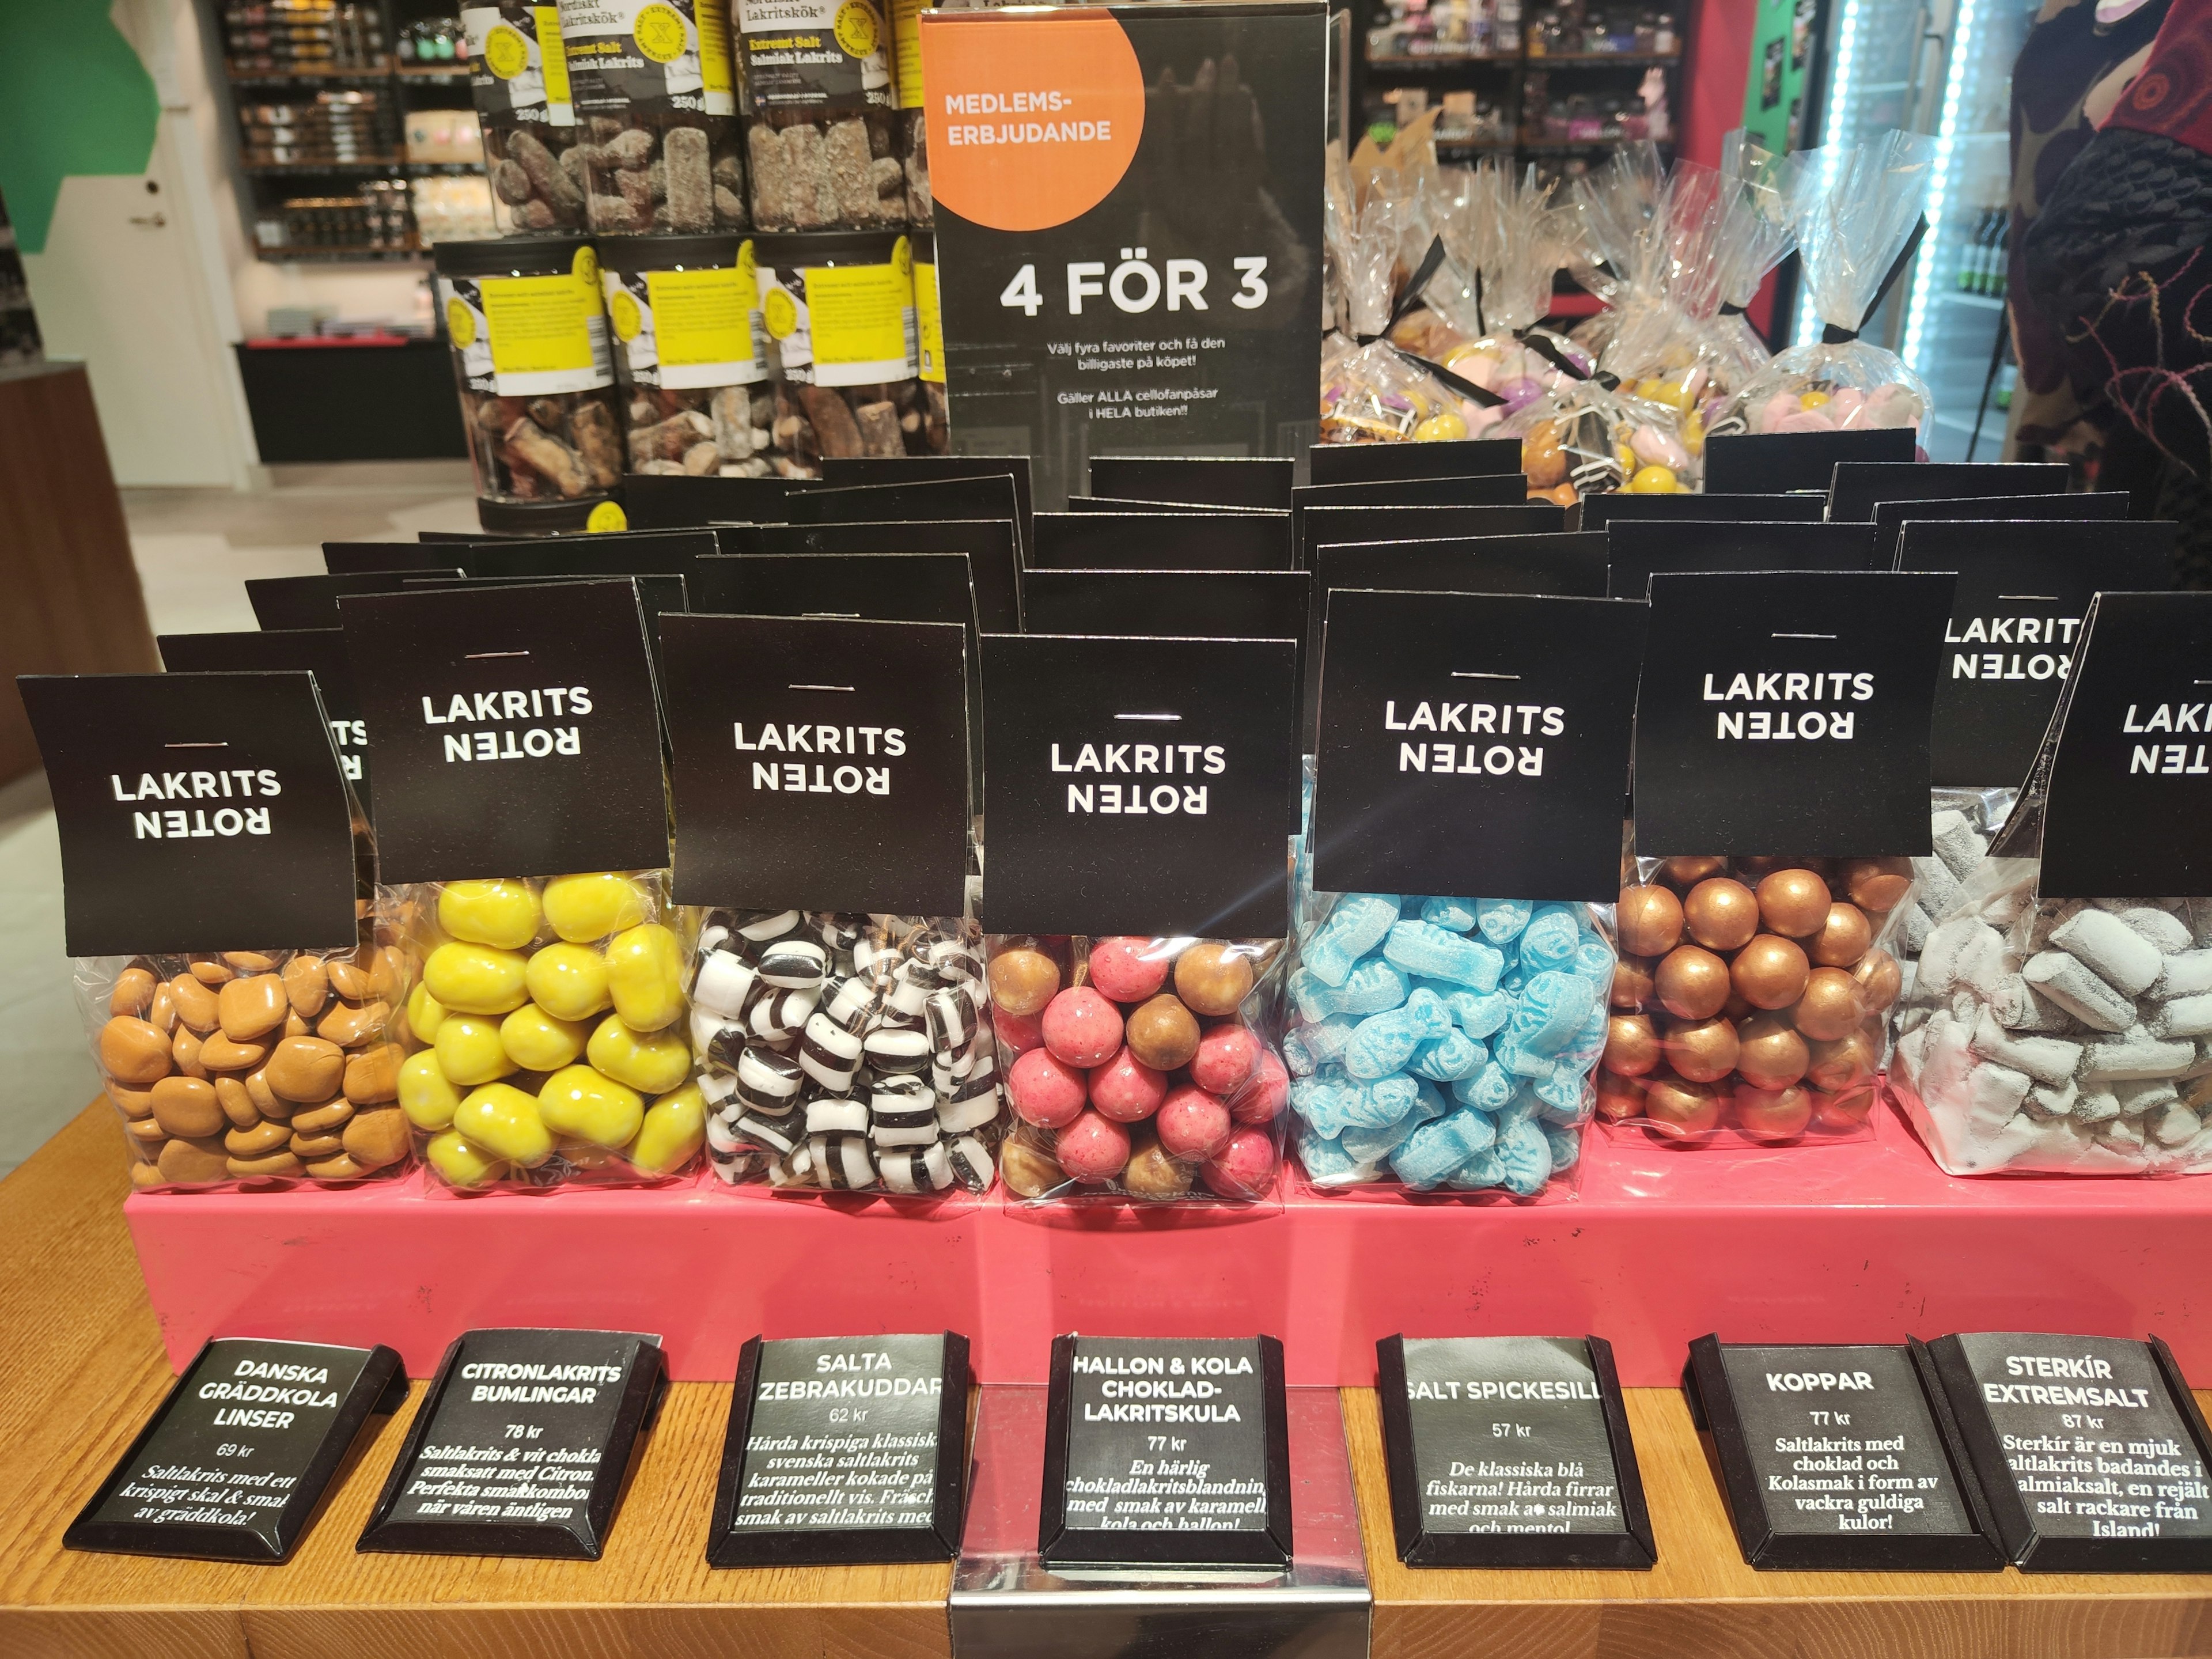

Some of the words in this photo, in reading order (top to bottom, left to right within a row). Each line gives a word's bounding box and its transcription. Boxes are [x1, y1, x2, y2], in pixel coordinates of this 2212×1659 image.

[672, 96, 696, 110] 250
[945, 90, 1072, 115] MEDLEMS-
[948, 120, 1112, 146] ERBJUDANDE
[1000, 264, 1043, 317] 4
[1067, 247, 1209, 315] FÖR
[1231, 256, 1268, 309] 3
[1047, 342, 1072, 356] Välj
[1074, 341, 1100, 356] fyra
[1103, 338, 1156, 353] favoriter
[1158, 338, 1183, 351] och
[1185, 337, 1199, 350] få
[1200, 336, 1226, 349] den
[1077, 357, 1134, 372] billigaste
[1137, 355, 1154, 371] på
[1156, 354, 1196, 369] köpet!
[1056, 391, 1094, 406] Gäller
[1097, 389, 1133, 403] ALLA
[1135, 388, 1219, 403] cellofanpåsar
[1088, 407, 1093, 421] i
[1096, 405, 1132, 419] HELA
[1134, 404, 1188, 418] butiken!!
[1703, 673, 1874, 700] LAKRITS
[422, 687, 593, 724] LAKRITS
[1385, 700, 1565, 736] LAKRITS
[1717, 711, 1855, 740] ROTEN
[443, 727, 581, 763] ROTEN
[734, 722, 906, 756] LAKRITS
[1051, 743, 1226, 775] LAKRITS
[1399, 742, 1544, 776] ROTEN
[111, 769, 282, 802] LAKRITS
[752, 762, 890, 795] ROTEN
[1068, 784, 1207, 815] ROTEN
[133, 807, 272, 839] ROTEN
[234, 1359, 329, 1384] DANSKA
[461, 1363, 623, 1382] CITRONLAKRITS
[816, 1352, 892, 1373] SALTA
[1073, 1355, 1164, 1374] HALLON
[1169, 1357, 1185, 1375] &
[1191, 1357, 1253, 1375] KOLA
[2006, 1354, 2113, 1380] STERKÍR
[757, 1377, 942, 1401] ZEBRAKUDDAR
[1101, 1380, 1222, 1399] CHOKLAD-
[1407, 1381, 1461, 1400] SALT
[1467, 1381, 1603, 1400] SPICKESILL
[1766, 1372, 1874, 1392] KOPPAR
[198, 1380, 338, 1408] GRÄDDKOLA
[471, 1385, 597, 1404] BUMLINGAR
[1983, 1383, 2149, 1408] EXTREMSALT
[213, 1408, 295, 1429] LINSER
[828, 1408, 849, 1423] 62
[853, 1407, 869, 1422] kr
[1084, 1403, 1241, 1423] LAKRITSKULA
[1809, 1411, 1830, 1426] 77
[1834, 1411, 1851, 1426] kr
[2062, 1414, 2082, 1429] 87
[2087, 1415, 2104, 1429] kr
[504, 1424, 524, 1439] 78
[525, 1424, 544, 1439] kr
[1491, 1423, 1511, 1437] 57
[1516, 1423, 1532, 1437] kr
[216, 1443, 237, 1457] 69
[237, 1444, 255, 1458] kr
[745, 1435, 798, 1451] Hårda
[800, 1433, 870, 1453] krispiga
[1147, 1435, 1168, 1452] 77
[1171, 1435, 1187, 1452] kr
[1775, 1436, 1862, 1453] Saltlakrits
[1865, 1435, 1904, 1451] med
[2003, 1435, 2071, 1452] Sterkír
[2074, 1438, 2096, 1453] är
[2100, 1441, 2124, 1455] en
[2128, 1440, 2181, 1459] mjuk
[418, 1445, 503, 1463] Saltlakrits
[503, 1447, 522, 1463] &
[523, 1448, 545, 1463] vit
[766, 1453, 834, 1469] svenska
[835, 1451, 920, 1468] saltlakrits
[1793, 1455, 1862, 1471] choklad
[1866, 1455, 1899, 1470] och
[141, 1464, 229, 1484] Saltlakrits
[229, 1470, 270, 1487] med
[270, 1475, 298, 1490] ett
[421, 1464, 498, 1480] smaksatt
[498, 1465, 537, 1480] med
[537, 1465, 594, 1482] Citron.
[1128, 1459, 1155, 1476] En
[1156, 1459, 1210, 1479] härlig
[1449, 1461, 1475, 1476] De
[1478, 1461, 1553, 1477] klassiska
[1557, 1461, 1584, 1477] blå
[2096, 1456, 2190, 1477] badandes
[2194, 1461, 2203, 1478] i
[747, 1472, 845, 1488] karameller
[844, 1469, 909, 1487] kokade
[910, 1468, 933, 1488] på
[1768, 1475, 1855, 1491] Kolasmak
[1857, 1474, 1863, 1490] i
[1868, 1474, 1914, 1490] form
[1917, 1476, 1938, 1489] av
[119, 1482, 189, 1504] krispigt
[188, 1486, 227, 1503] skal
[224, 1489, 243, 1505] &
[407, 1480, 481, 1497] Perfekta
[740, 1489, 844, 1507] traditionellt
[848, 1489, 876, 1505] vis.
[1426, 1480, 1502, 1498] fiskarna!
[1506, 1480, 1562, 1497] Hårda
[1565, 1481, 1614, 1497] firrar
[2128, 1483, 2154, 1497] en
[2157, 1482, 2210, 1502] rejält
[416, 1501, 452, 1514] när
[451, 1501, 503, 1517] våren
[499, 1503, 574, 1521] äntligen
[1066, 1497, 1108, 1513] med
[1113, 1497, 1162, 1514] smak
[1164, 1501, 1187, 1514] av
[1428, 1500, 1469, 1516] med
[1472, 1500, 1520, 1516] smak
[1547, 1500, 1618, 1517] salmiak
[1795, 1495, 1853, 1510] vackra
[1857, 1494, 1923, 1514] guldiga
[2037, 1497, 2071, 1515] salt
[2076, 1499, 2151, 1518] rackare
[2154, 1501, 2199, 1520] från
[133, 1508, 160, 1520] av
[153, 1506, 257, 1526] gräddkola!
[735, 1509, 783, 1525] smak
[785, 1512, 806, 1525] av
[809, 1508, 895, 1525] saltlakrits
[1838, 1514, 1892, 1530] kulor!
[2093, 1520, 2160, 1537] Island!
